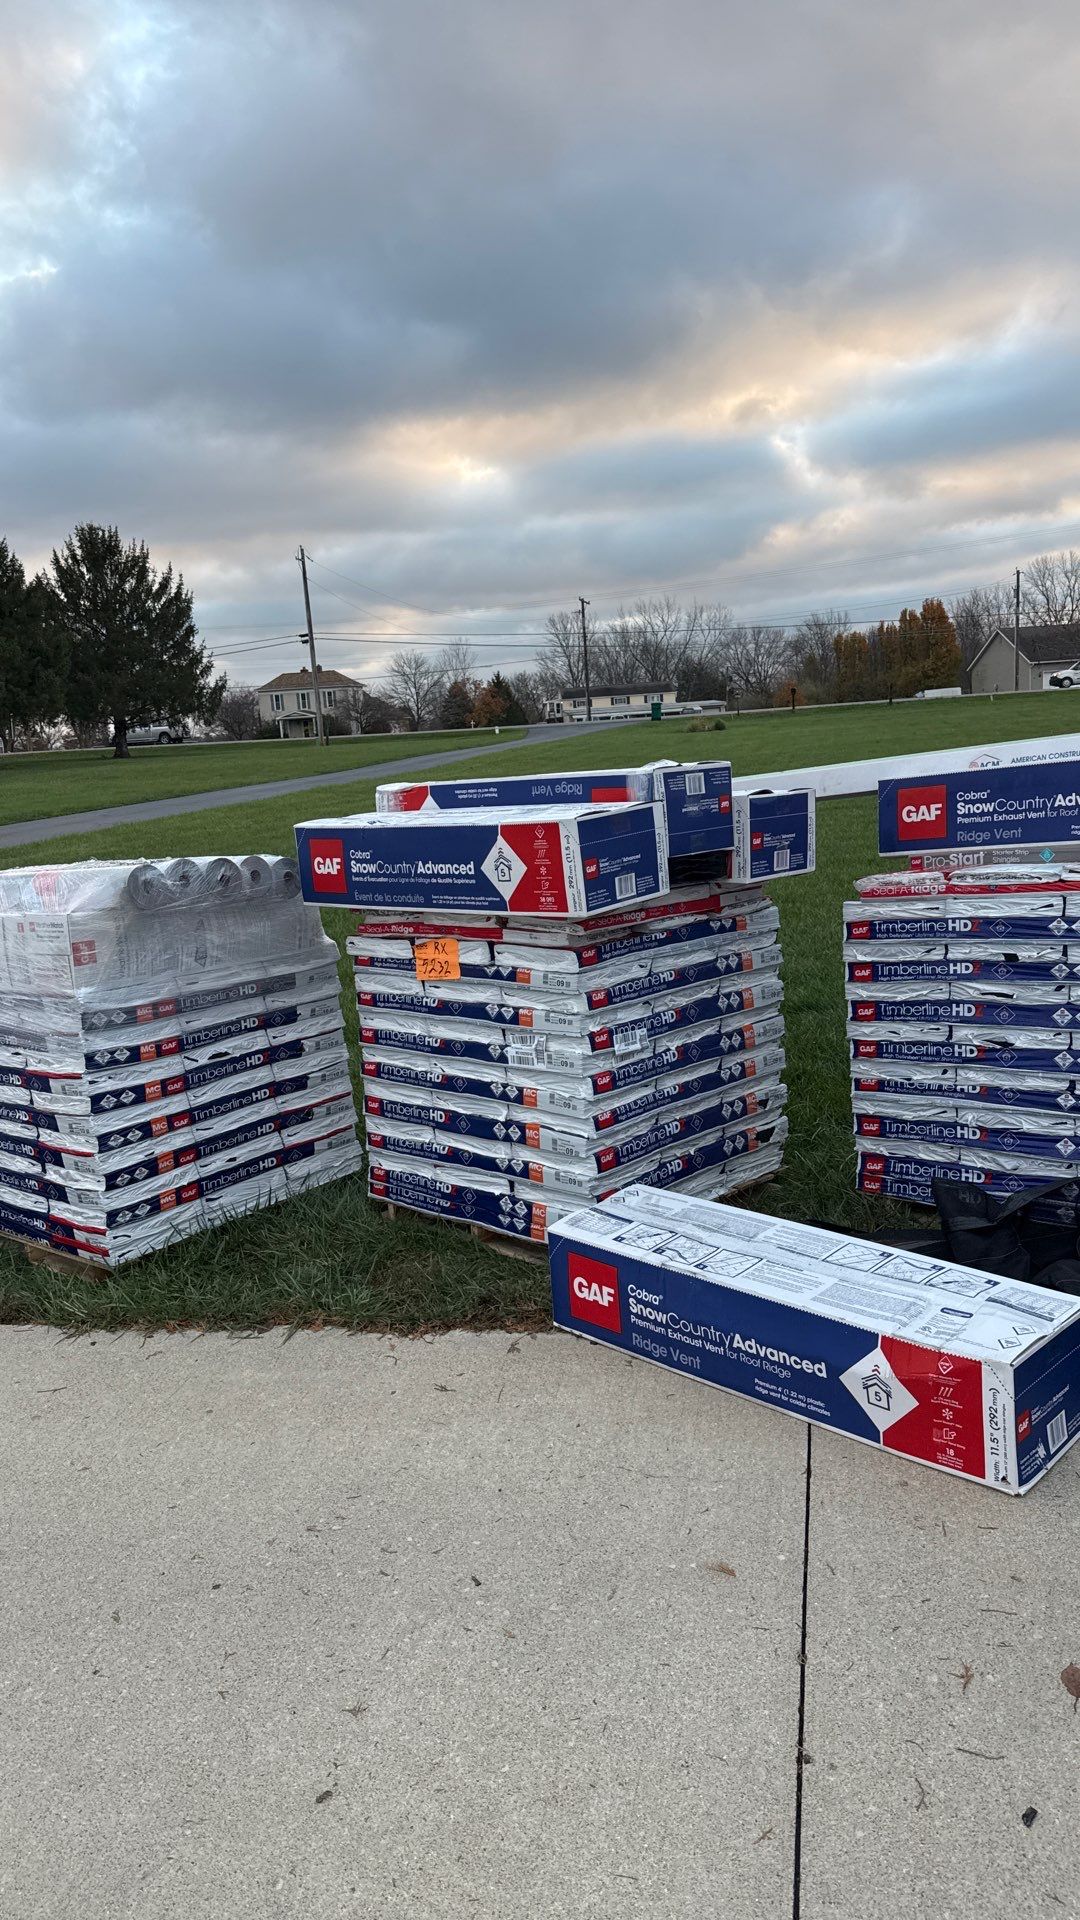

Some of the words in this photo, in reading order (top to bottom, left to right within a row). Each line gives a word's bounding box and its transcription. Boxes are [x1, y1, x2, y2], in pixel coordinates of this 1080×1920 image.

[1011, 754, 1047, 764] AMERICAN
[531, 784, 553, 797] Vent
[555, 782, 583, 795] Ridge
[902, 803, 943, 823] GAF
[957, 815, 991, 824] Premium
[994, 812, 1025, 821] Exhaust
[1027, 811, 1045, 819] Vent
[1047, 809, 1057, 818] for
[1060, 808, 1078, 817] Roof
[957, 830, 990, 843] Ridge
[994, 827, 1022, 839] Vent
[313, 856, 342, 875] GAF
[924, 853, 986, 869] Pro-Start
[993, 855, 1021, 864] Shingles
[417, 861, 475, 875] Advanced
[501, 868, 506, 877] 5
[586, 865, 597, 873] GAF
[374, 892, 383, 901] de
[385, 892, 391, 902] la
[393, 893, 425, 904] conduite
[434, 942, 449, 955] RX
[583, 950, 595, 958] GAF
[592, 992, 607, 1001] GAF
[595, 1034, 608, 1043] GAF
[140, 1044, 156, 1053] MC
[162, 1041, 177, 1050] GAF
[597, 1076, 610, 1085] GAF
[146, 1084, 161, 1094] MC
[167, 1081, 183, 1090] GAF
[524, 1089, 537, 1097] MC
[598, 1111, 611, 1121] GAF
[152, 1122, 167, 1131] MC
[173, 1118, 189, 1127] GAF
[526, 1129, 539, 1138] MC
[566, 1148, 573, 1156] 09
[601, 1153, 614, 1163] GAF
[158, 1160, 174, 1169] MC
[179, 1153, 195, 1163] GAF
[569, 1178, 576, 1186] 09
[864, 1181, 880, 1189] GAF
[160, 1194, 176, 1204] MC
[181, 1189, 197, 1199] GAF
[533, 1207, 545, 1217] MC
[573, 1276, 615, 1307] GAF
[630, 1315, 667, 1336] Premium
[668, 1329, 702, 1347] Exhaust
[703, 1340, 724, 1355] Vent
[726, 1348, 738, 1360] for
[740, 1352, 761, 1368] Roof
[763, 1360, 791, 1379] Ridge
[632, 1333, 667, 1358] Ridge
[670, 1346, 701, 1369] Vent
[733, 1333, 827, 1379] Advanced
[874, 1391, 882, 1402] 5
[1019, 1418, 1030, 1433] GAF
